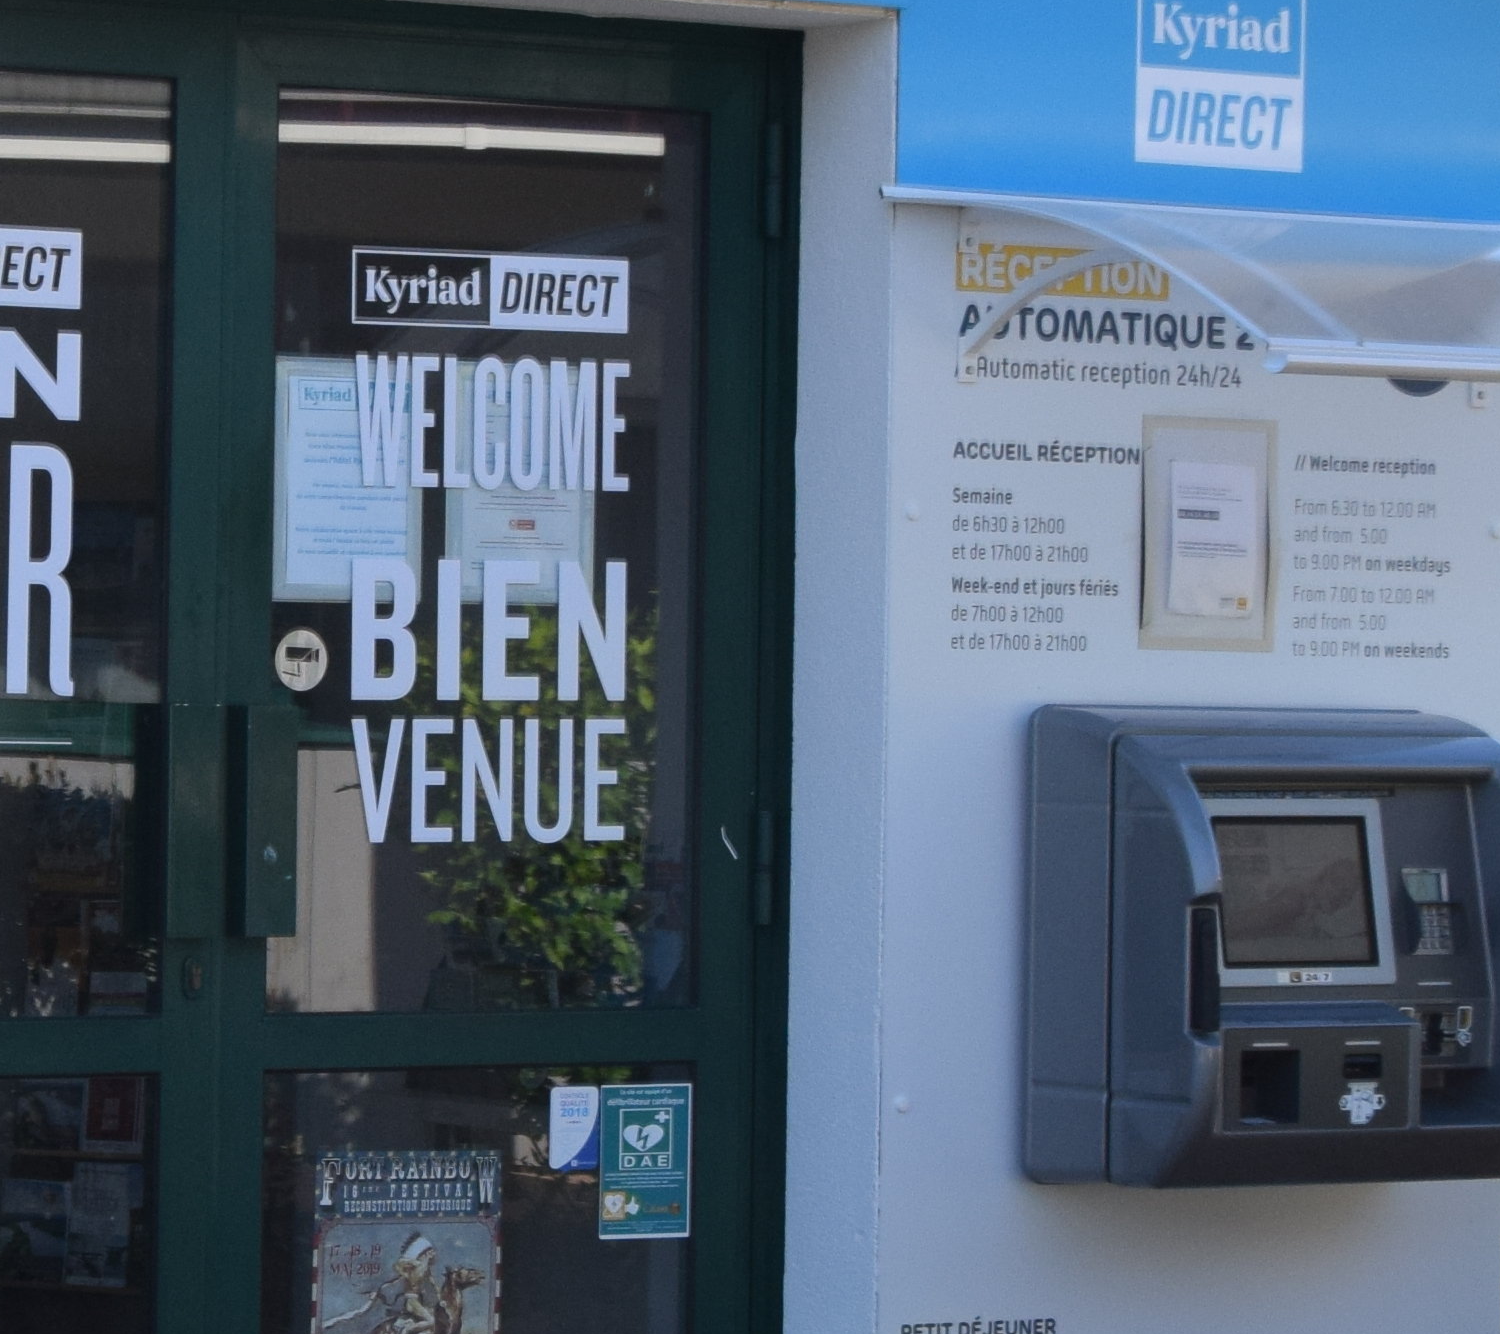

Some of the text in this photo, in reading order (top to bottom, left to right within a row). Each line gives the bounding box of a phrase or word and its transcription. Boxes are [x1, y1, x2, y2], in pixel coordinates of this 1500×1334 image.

[1145, 89, 1295, 155] DIRECT
[362, 262, 620, 320] Kyriad DIRECT
[976, 356, 1242, 391] Automatic reception 24h/24
[303, 385, 353, 406] Kyriad
[353, 351, 631, 493] WELCOME
[953, 441, 1140, 465] ACCUEIL RÉCEPTION
[952, 487, 1012, 504] Semaine
[952, 514, 1065, 534] de 6h30 à 12h00
[951, 543, 1088, 563] et de 17h00 à 21h00
[951, 576, 1118, 598] Week-end et jours fériés
[950, 604, 1063, 623] de 7h00 à 12h00
[348, 557, 630, 704] BIEN
[950, 632, 1087, 652] et de 17h00 à 21h00
[348, 717, 627, 846] VENUE
[560, 1107, 589, 1117] 2018
[623, 1154, 669, 1168] DAE
[389, 1183, 473, 1198] FESTIVAL
